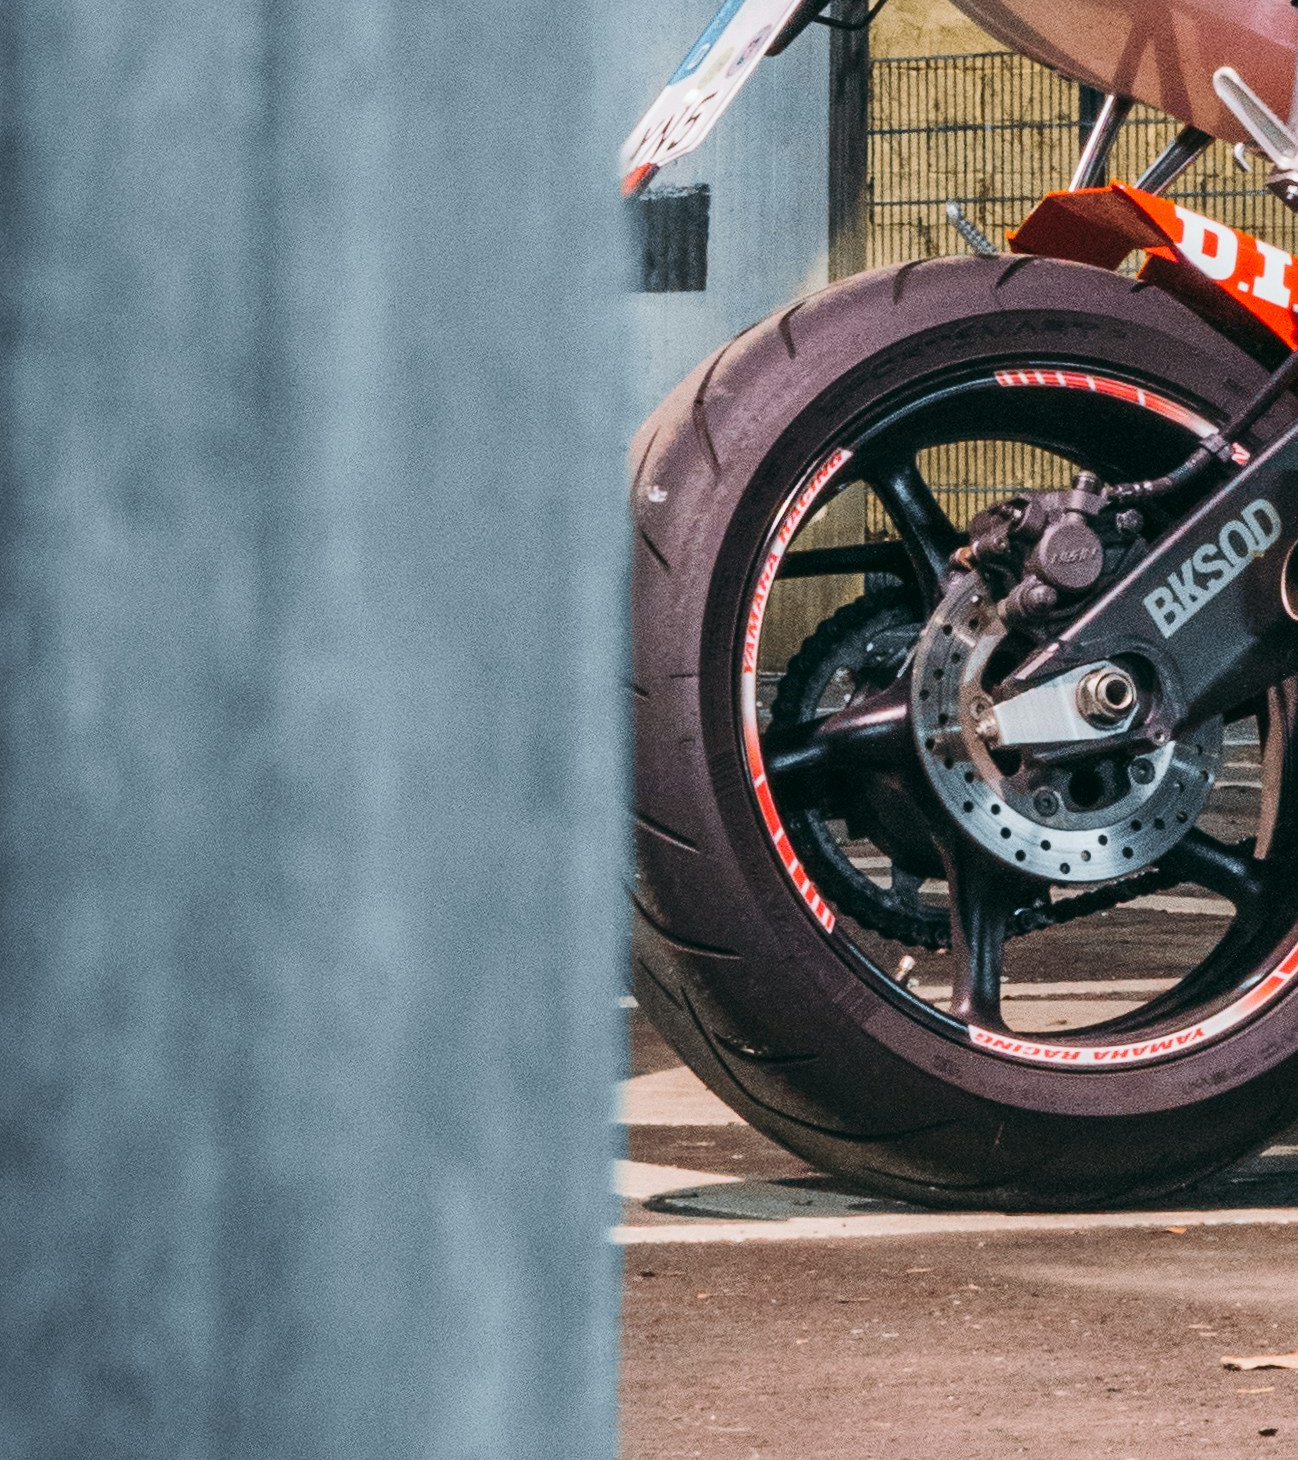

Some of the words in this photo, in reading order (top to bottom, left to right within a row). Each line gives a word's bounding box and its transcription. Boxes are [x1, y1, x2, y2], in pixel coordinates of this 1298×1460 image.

[742, 553, 779, 674] YAMAHA
[778, 448, 843, 545] RACING
[1143, 498, 1282, 639] BKSOD
[974, 1032, 1081, 1061] RACING
[1093, 1027, 1207, 1061] YAMAHA
